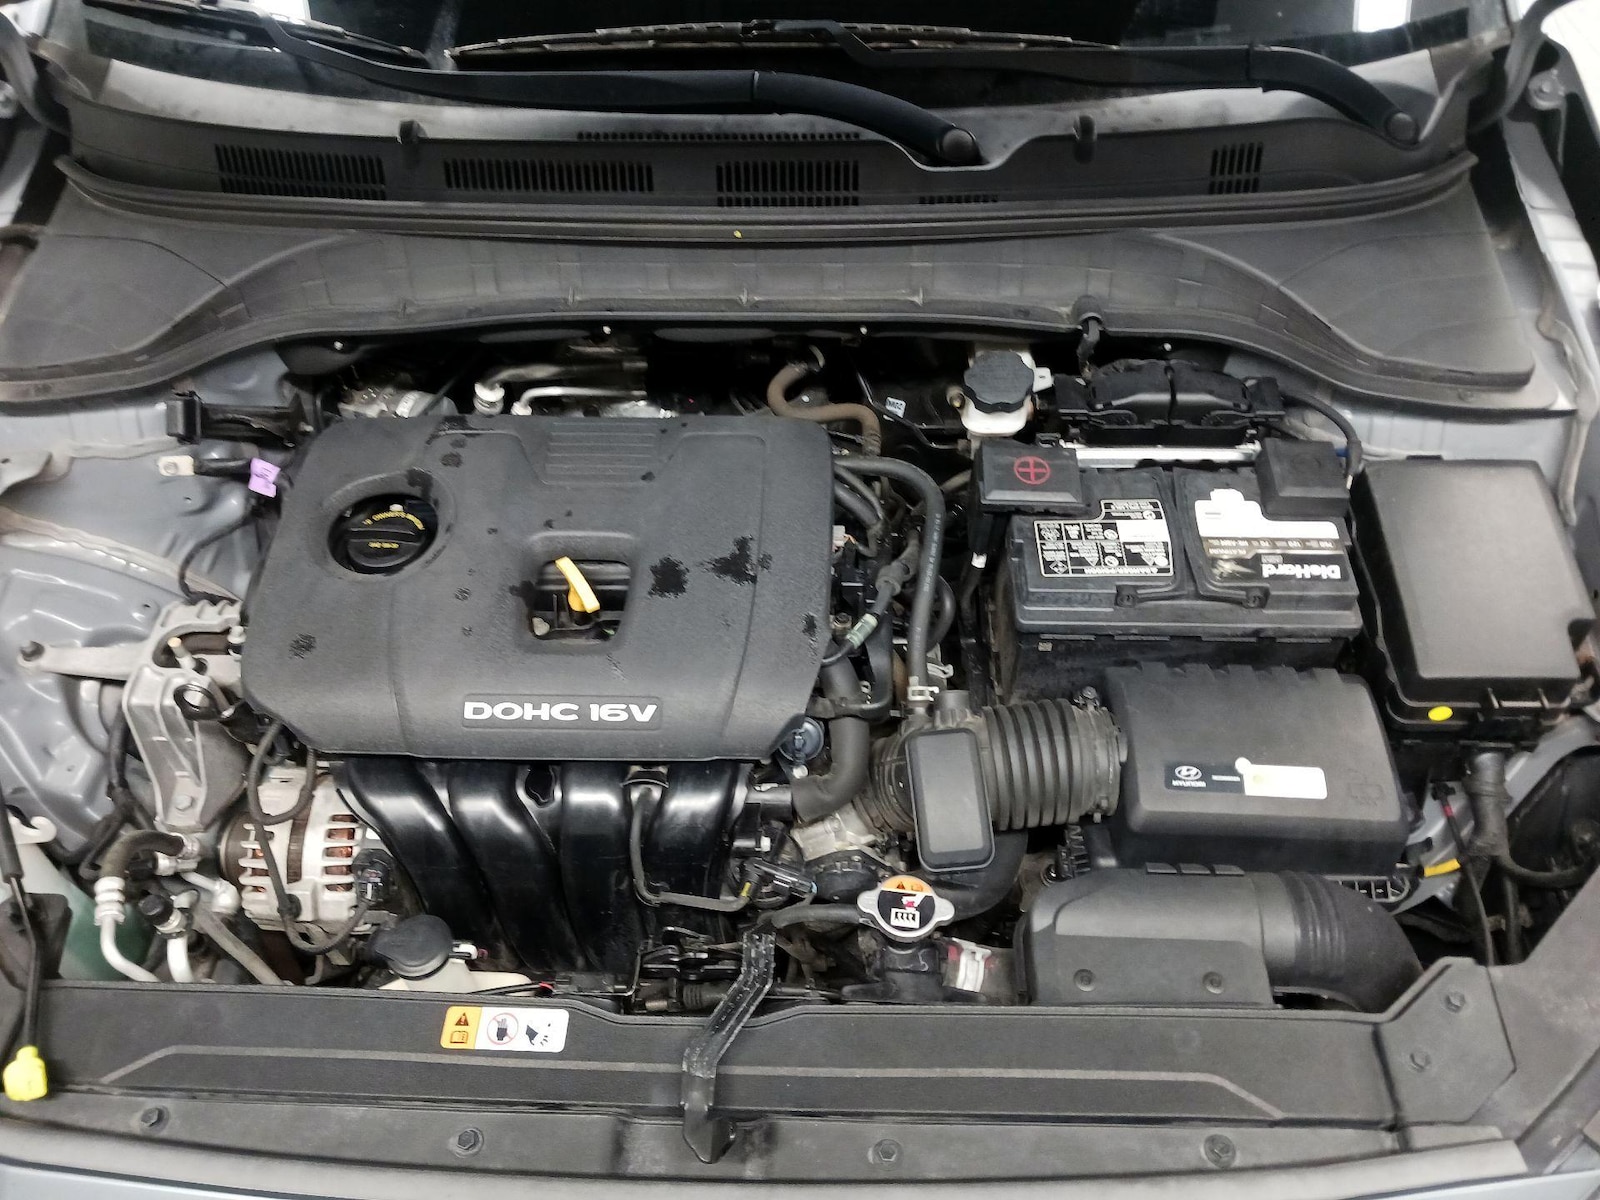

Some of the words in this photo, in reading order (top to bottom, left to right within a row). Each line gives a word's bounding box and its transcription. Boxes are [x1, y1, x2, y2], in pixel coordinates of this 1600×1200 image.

[1262, 564, 1342, 580] DieHard
[463, 701, 580, 722] DOHC
[590, 703, 658, 723] 16V
